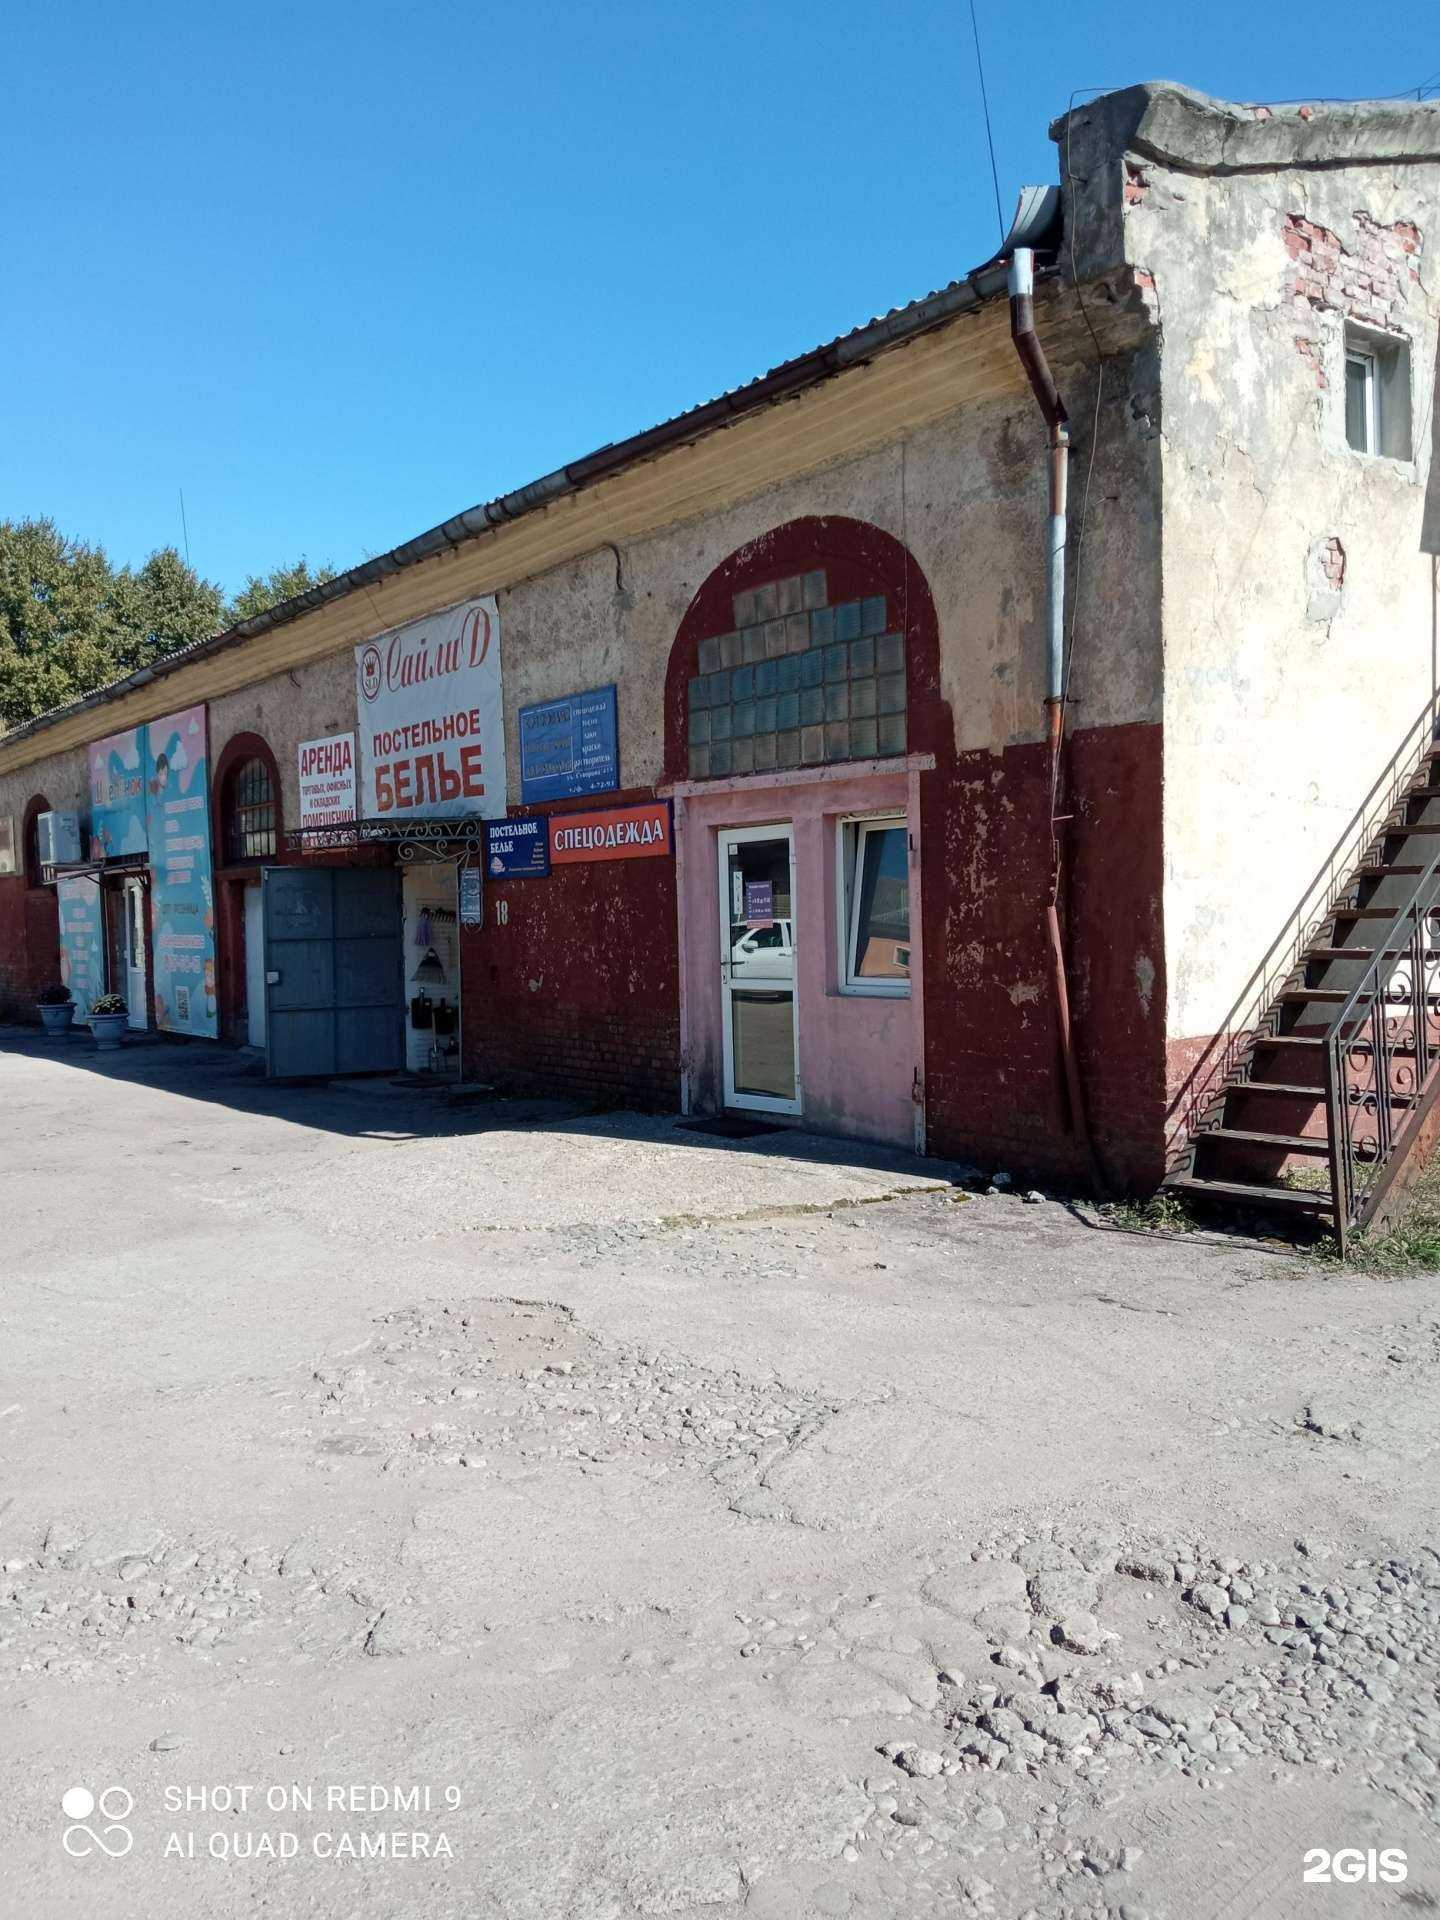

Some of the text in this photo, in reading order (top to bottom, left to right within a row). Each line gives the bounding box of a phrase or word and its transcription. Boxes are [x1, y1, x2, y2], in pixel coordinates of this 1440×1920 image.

[373, 708, 480, 757] ПОСТЕЛЬНОЕ
[301, 741, 352, 777] АРЕНДА
[375, 744, 484, 812] БЕЛЬЕ
[489, 822, 538, 838] ПОСТЕЛЬНОЕ
[554, 819, 664, 850] СПЕЦОДЕЖДА
[490, 841, 514, 854] БЕЛЬЕ
[495, 900, 508, 925] 18
